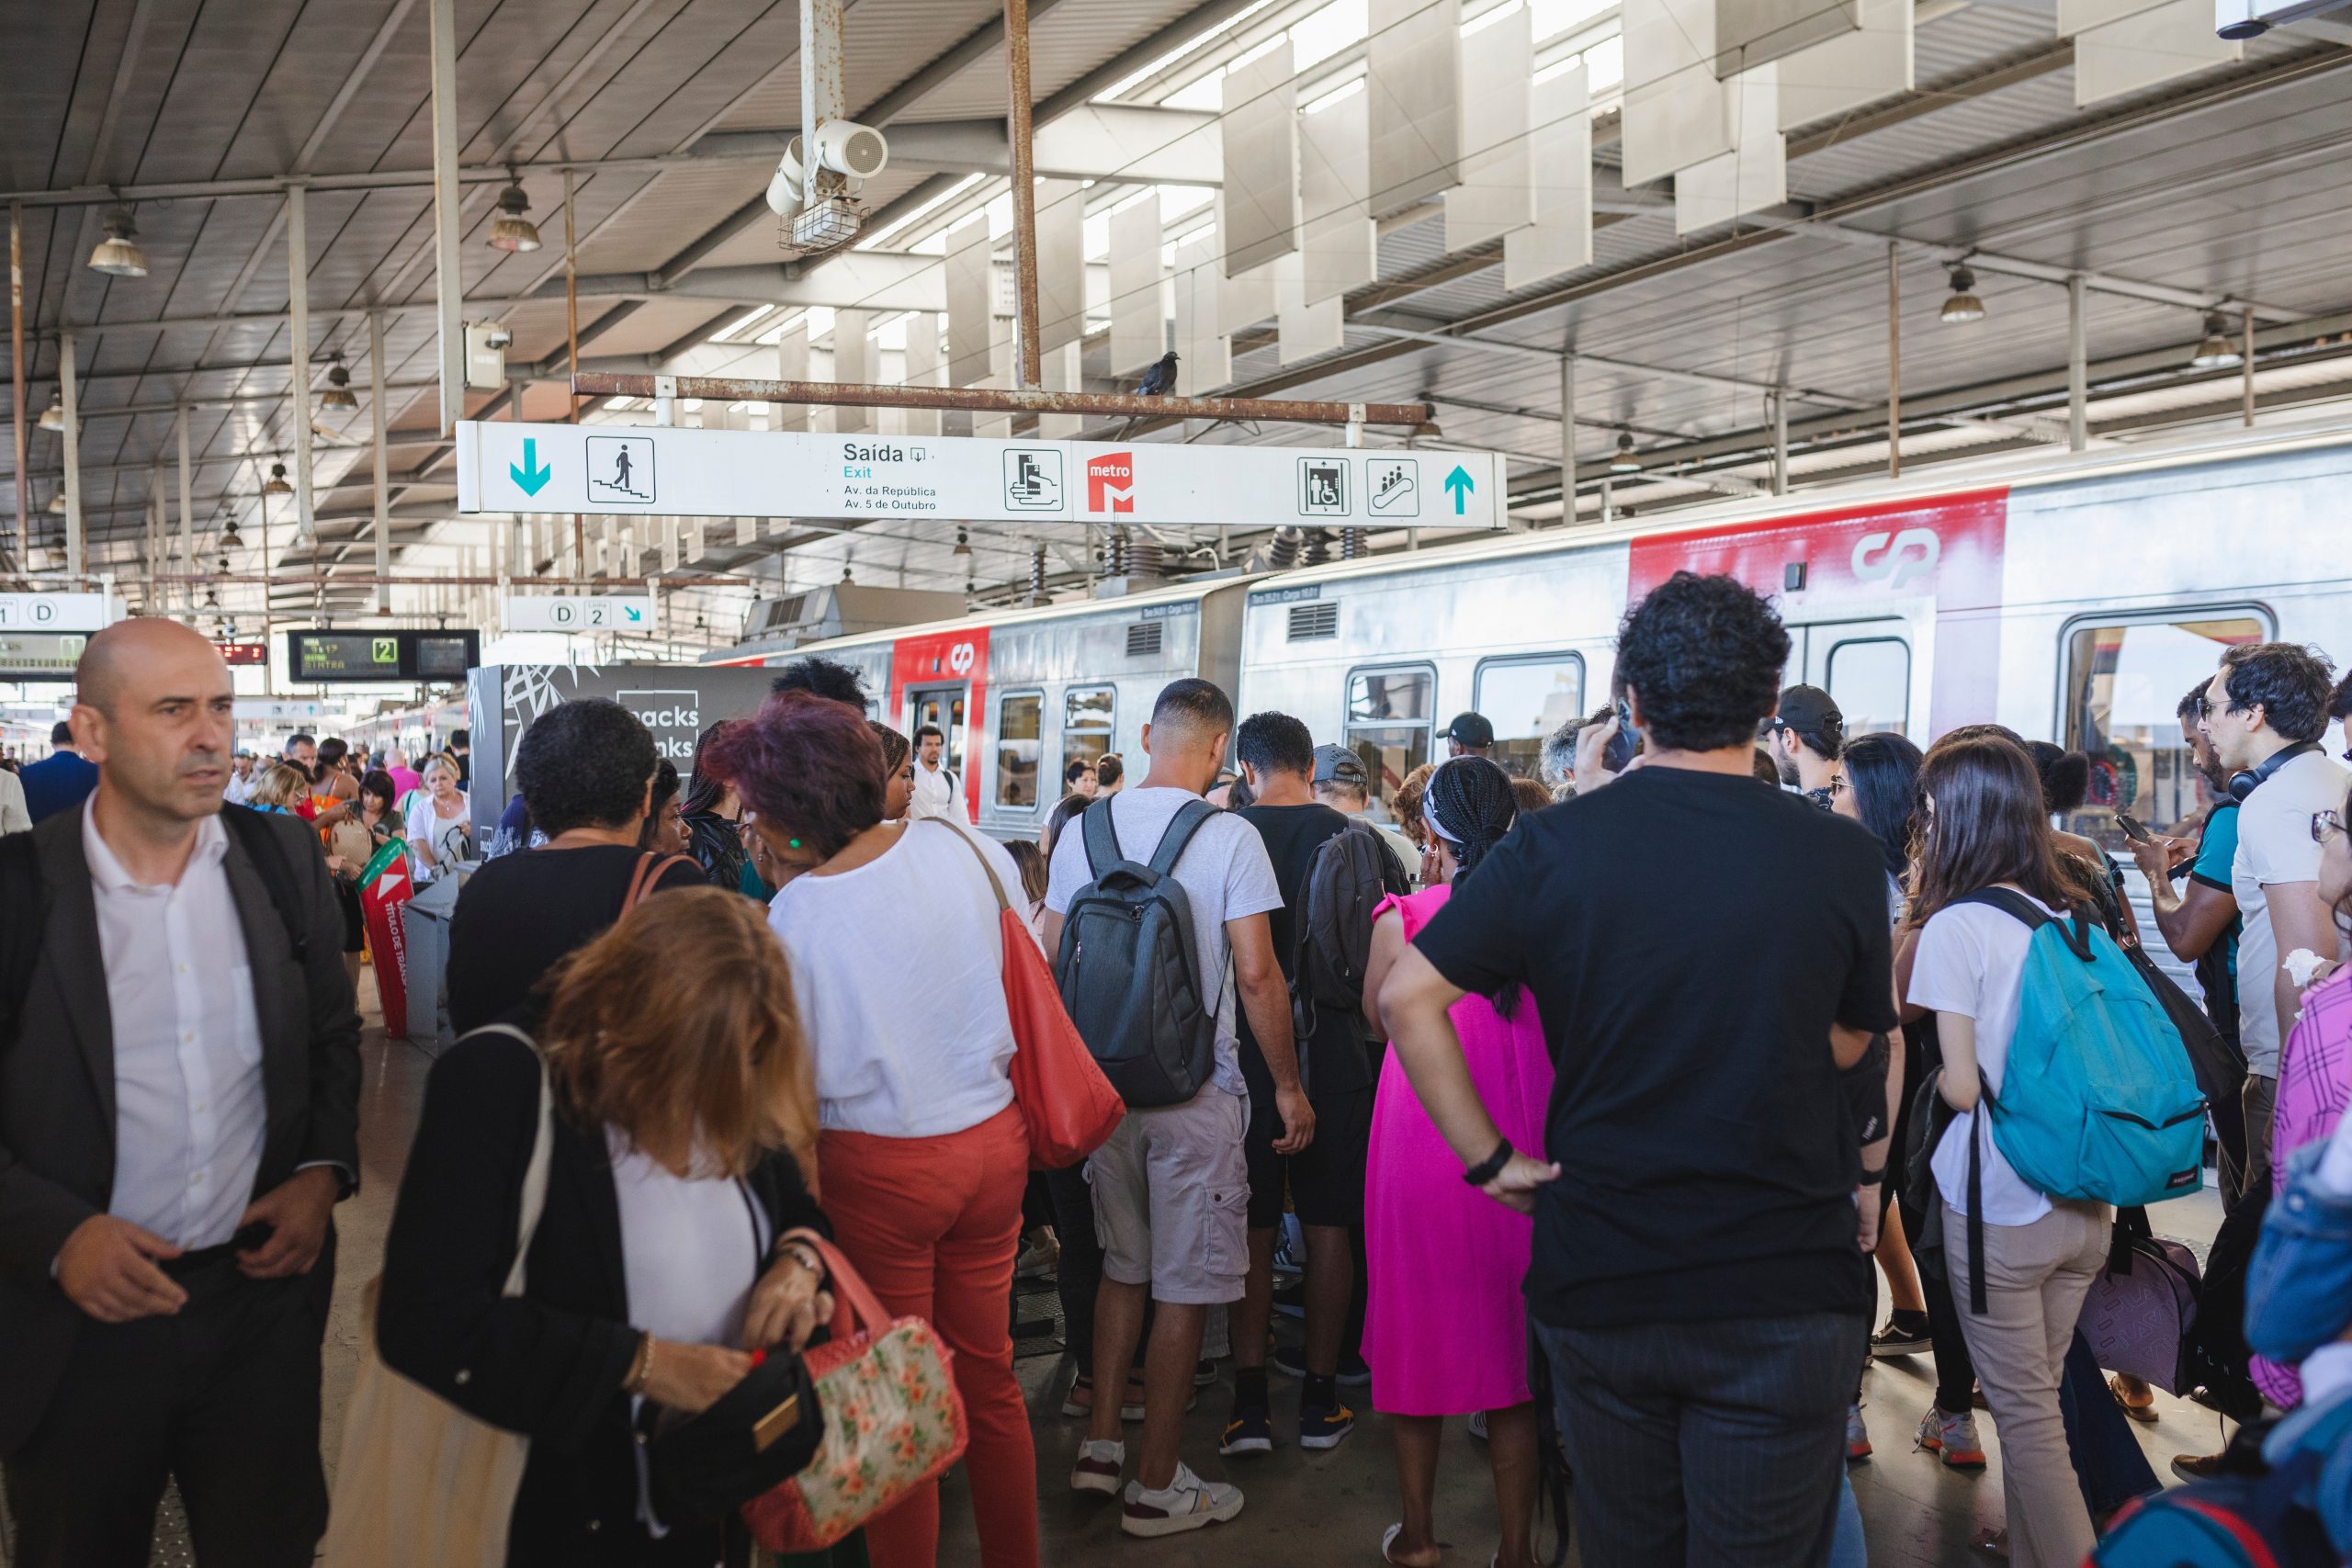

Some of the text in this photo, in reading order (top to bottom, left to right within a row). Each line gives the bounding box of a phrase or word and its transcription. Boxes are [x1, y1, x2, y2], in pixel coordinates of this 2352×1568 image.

[843, 443, 903, 462] Saída
[843, 466, 872, 479] Exit
[1090, 464, 1130, 478] metro
[844, 485, 936, 498] Av. da República
[844, 499, 936, 511] Av. 5 de Outubro
[37, 605, 51, 621] D
[558, 607, 603, 626] D 2
